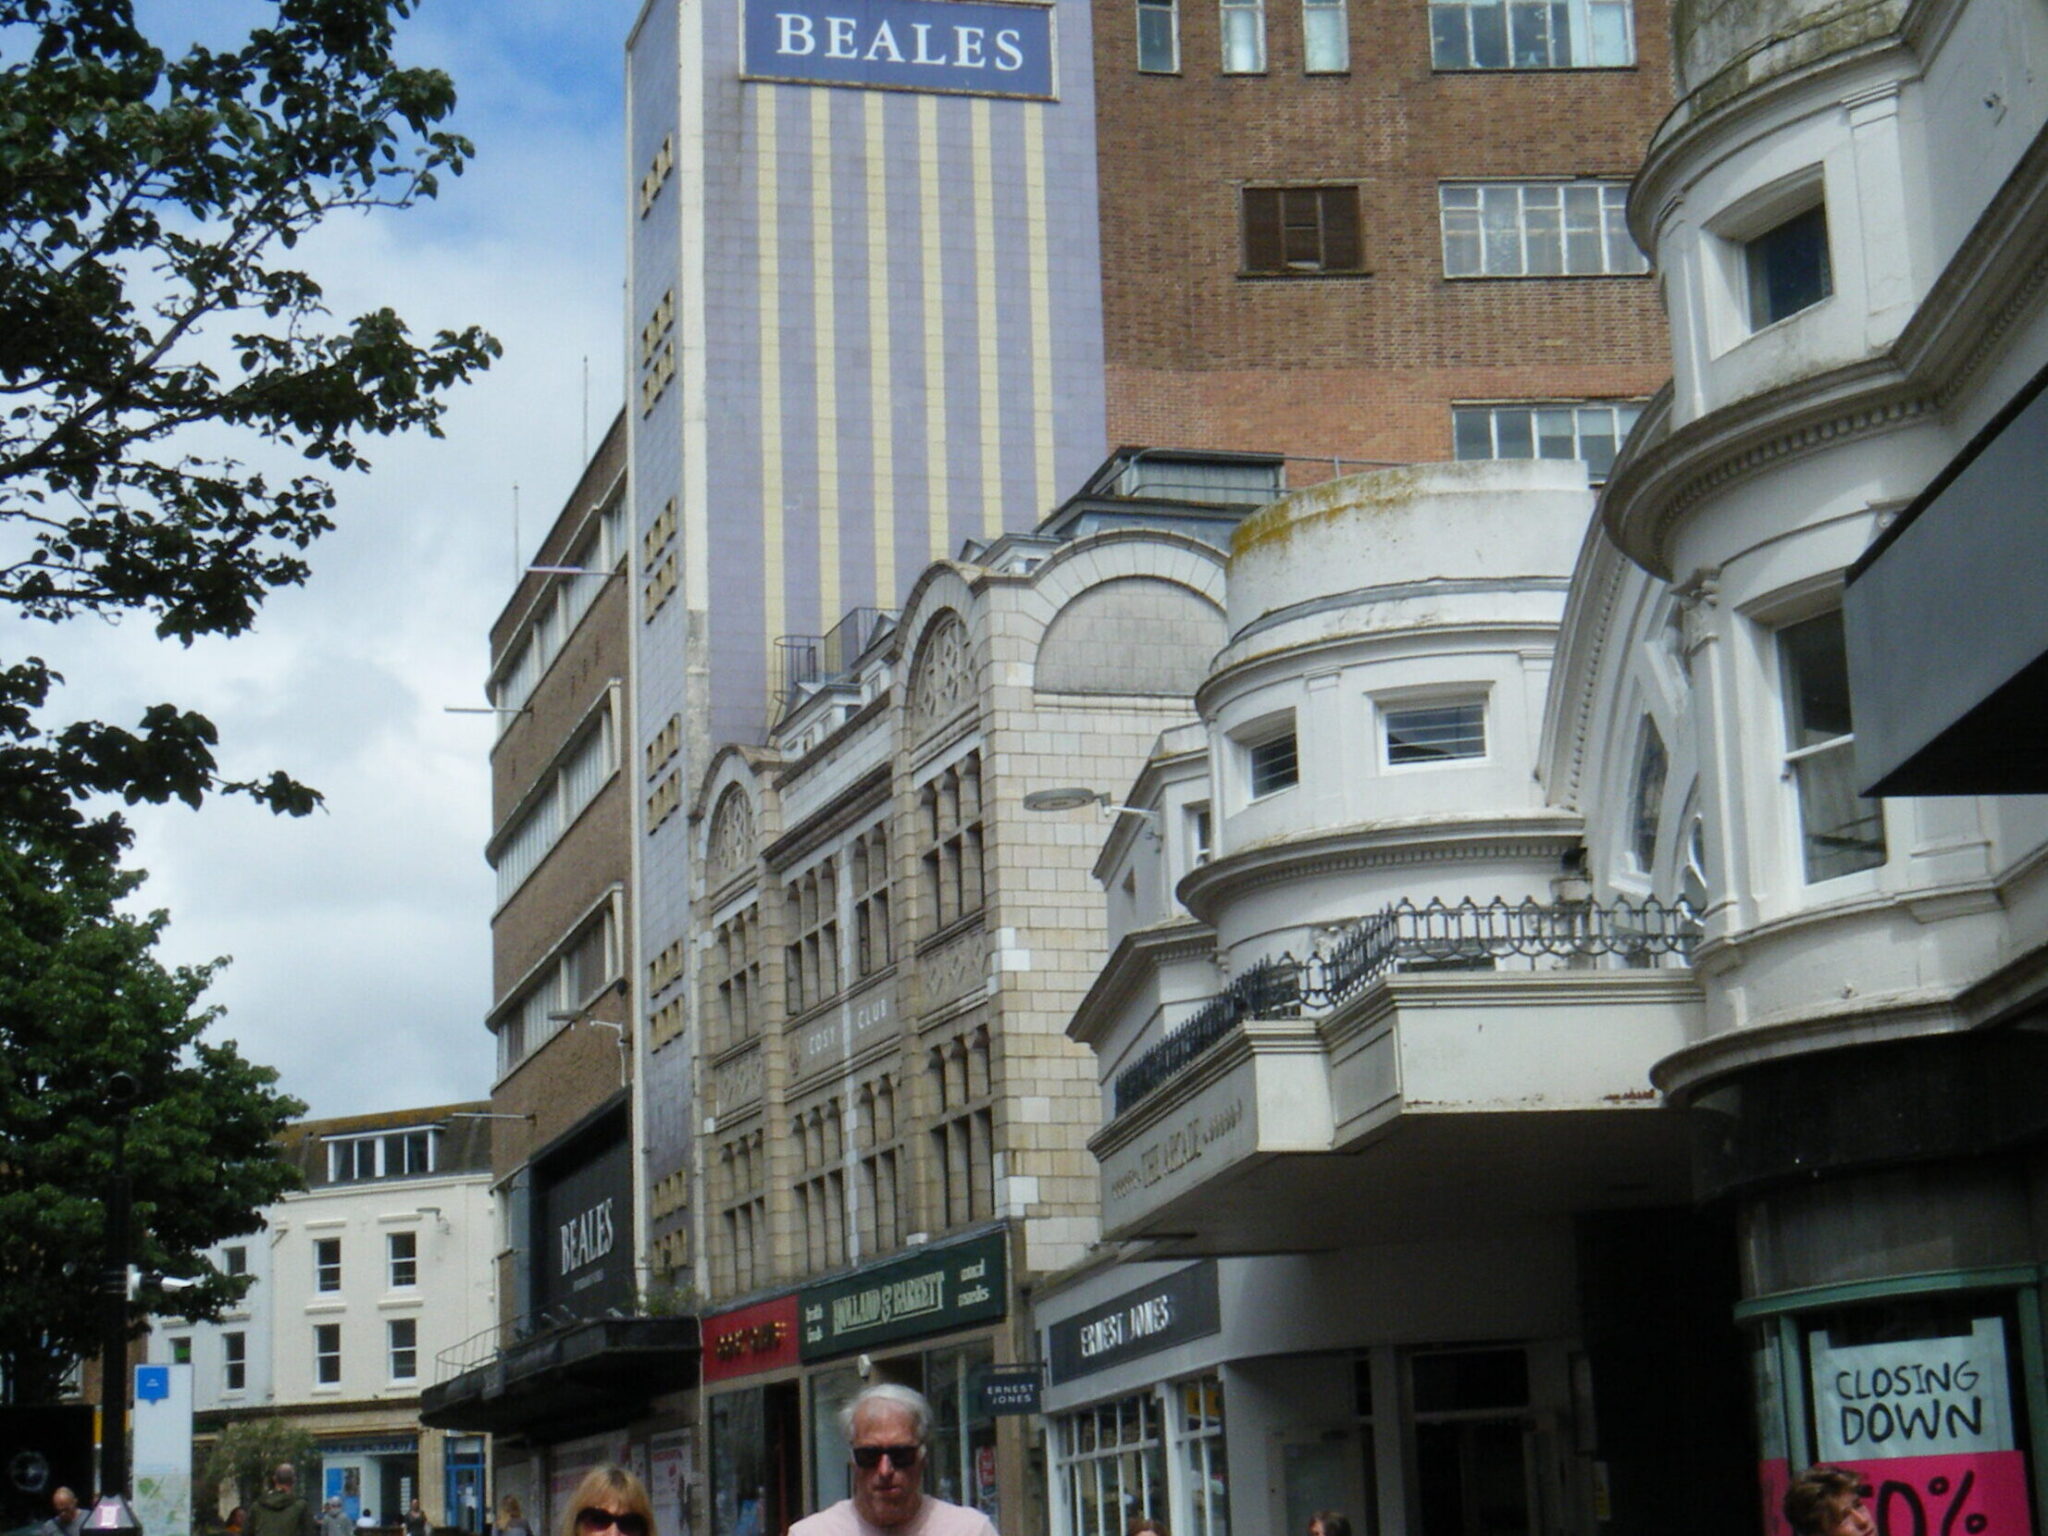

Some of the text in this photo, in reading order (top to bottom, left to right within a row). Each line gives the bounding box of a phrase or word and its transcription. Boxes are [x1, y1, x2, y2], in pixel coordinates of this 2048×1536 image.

[775, 13, 1023, 71] BEALES
[857, 998, 888, 1030] CLUB
[560, 1197, 613, 1276] BEALES
[1080, 1294, 1169, 1358] ERNEST JONES
[986, 1382, 1035, 1395] ERNEST
[992, 1394, 1032, 1405] JONES
[1836, 1360, 1979, 1400] CLOSING
[1840, 1395, 1982, 1446] DOWN
[1857, 1469, 1988, 1536] 0%
